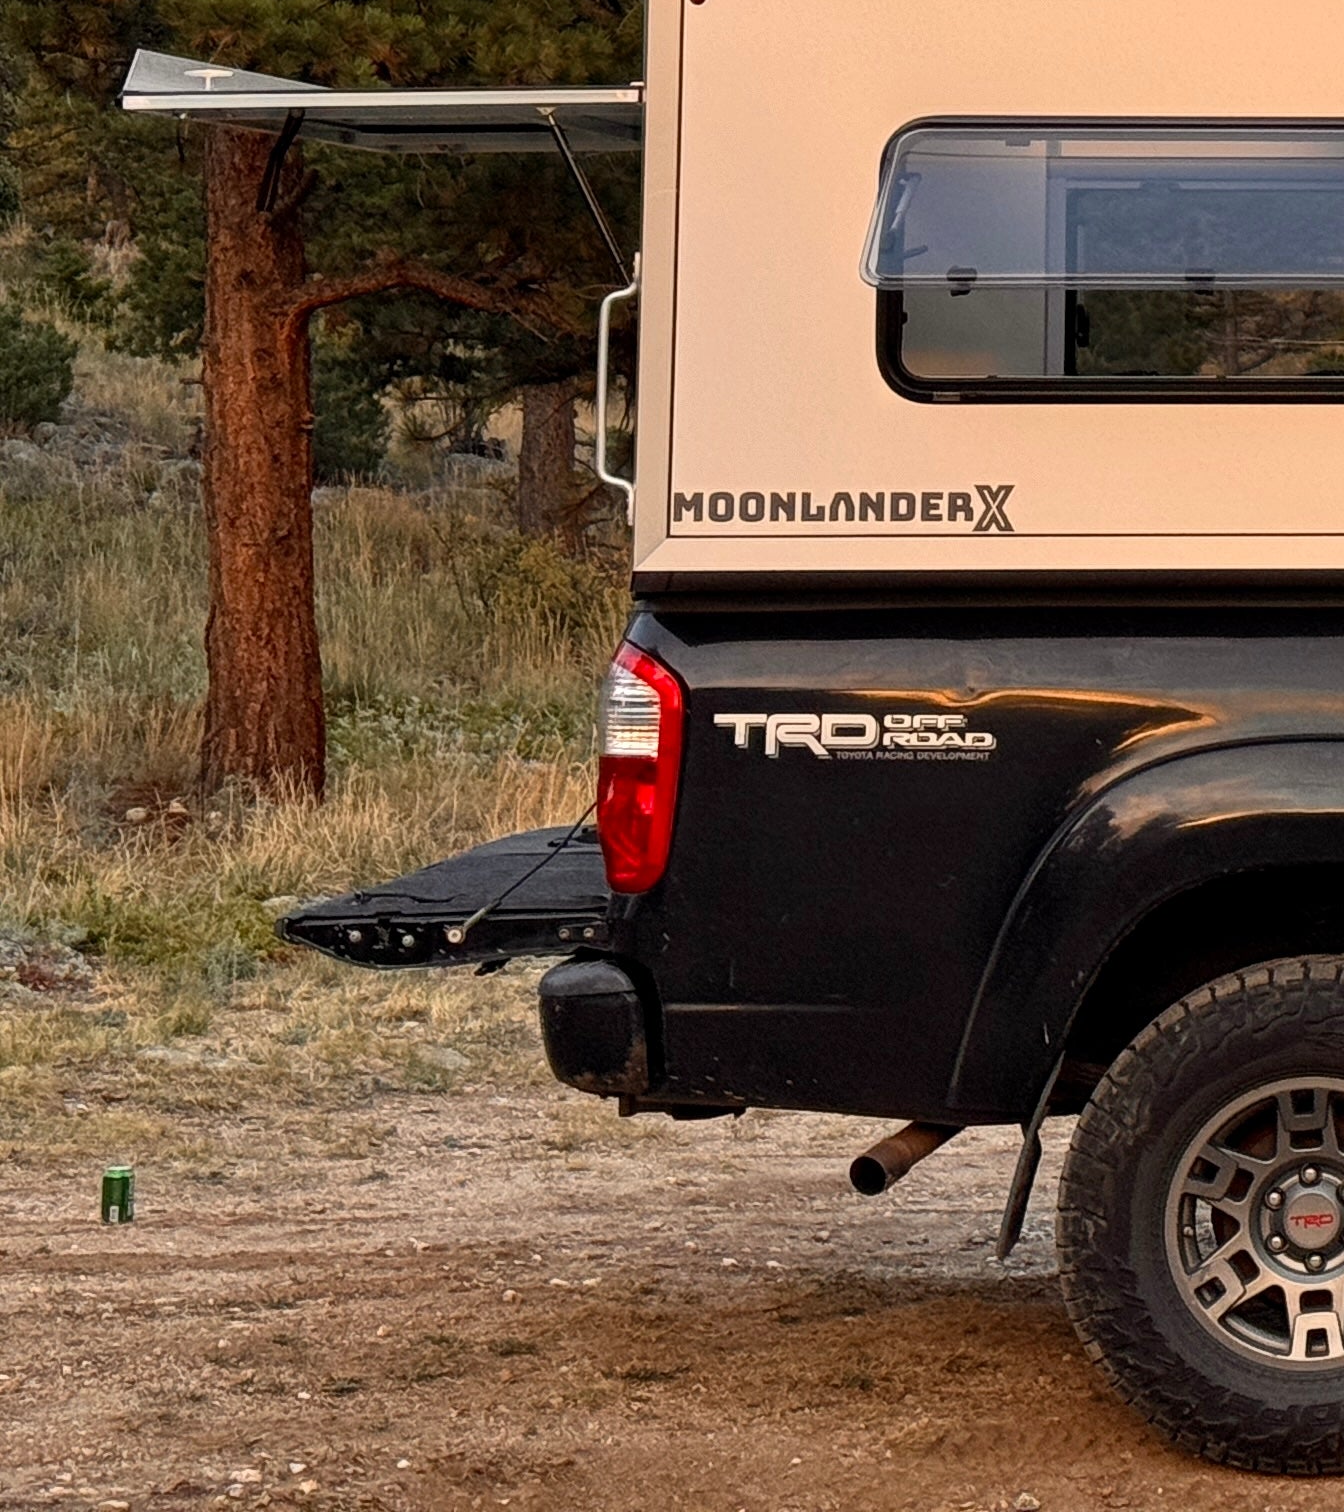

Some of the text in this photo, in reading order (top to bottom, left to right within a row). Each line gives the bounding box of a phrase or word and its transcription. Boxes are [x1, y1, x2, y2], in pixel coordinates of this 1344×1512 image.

[883, 714, 968, 731] OFF
[713, 713, 880, 759] TRD
[883, 732, 997, 750] ROAD
[836, 751, 990, 761] TOYOTA RACING DEVELOPMENT
[1290, 1214, 1334, 1229] TRD
